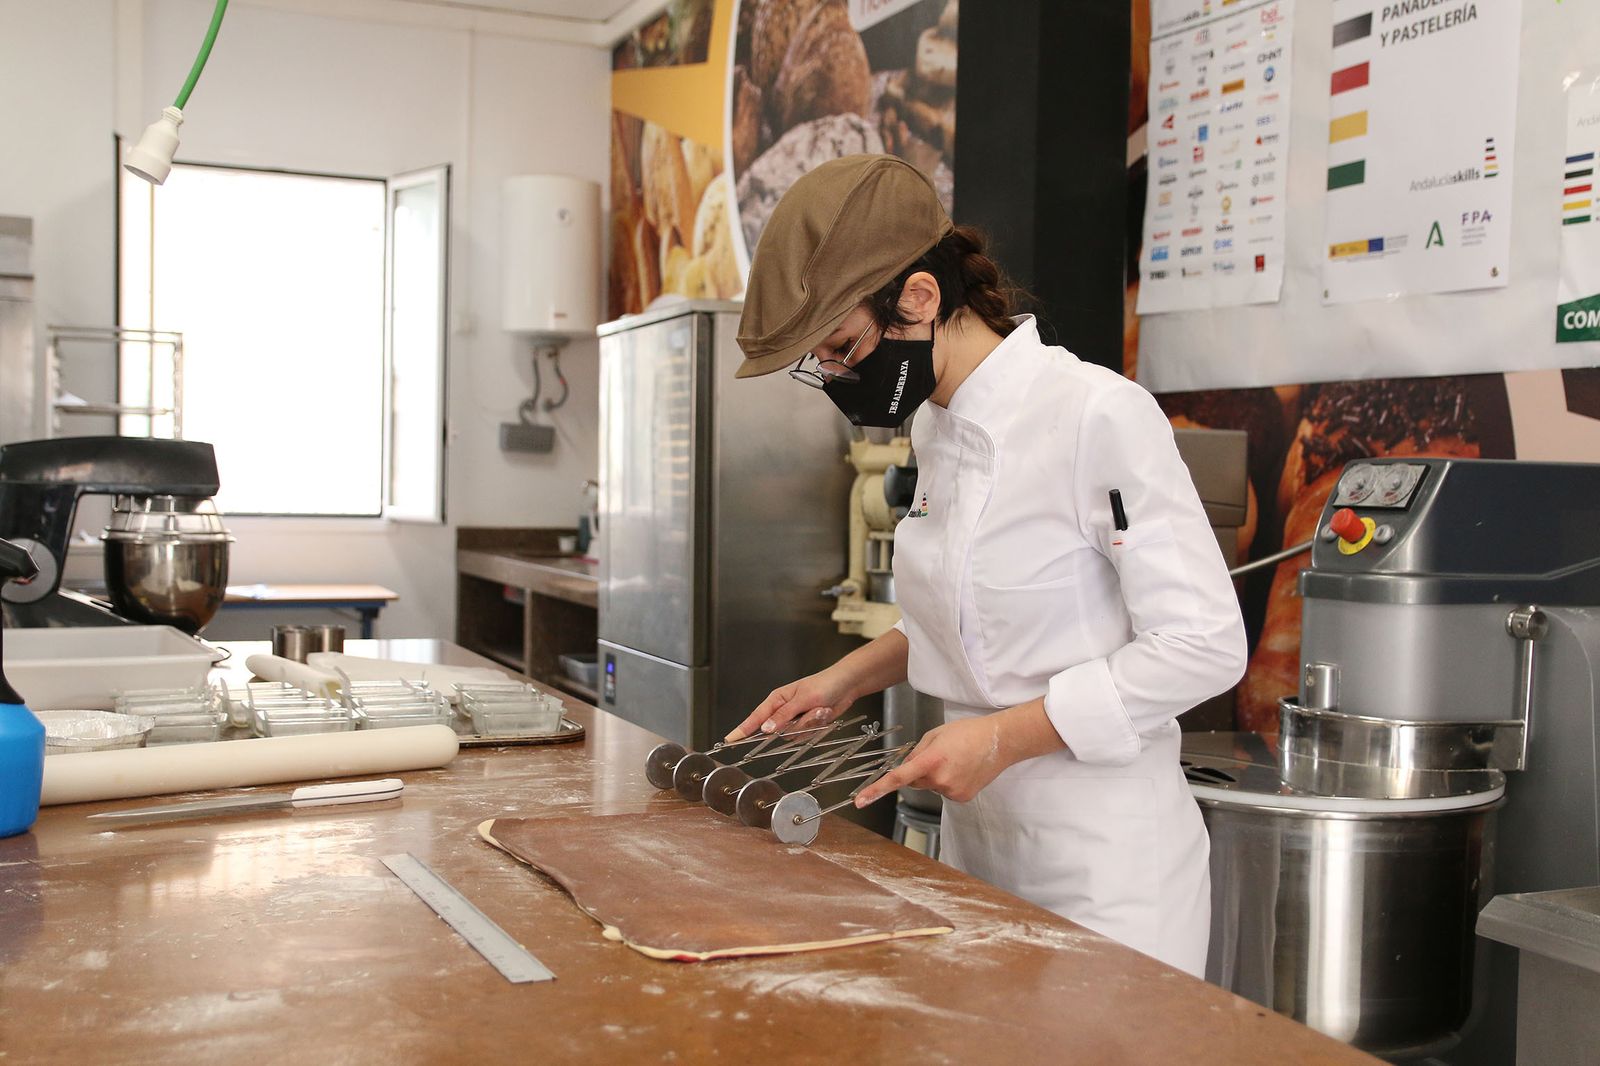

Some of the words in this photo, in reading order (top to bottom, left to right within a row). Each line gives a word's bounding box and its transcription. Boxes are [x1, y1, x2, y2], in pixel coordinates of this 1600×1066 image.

[1380, 31, 1389, 47] Y
[1391, 3, 1477, 44] PASTELERÍA
[1461, 209, 1493, 225] FPA
[1564, 310, 1600, 329] COM
[889, 401, 899, 414] IES
